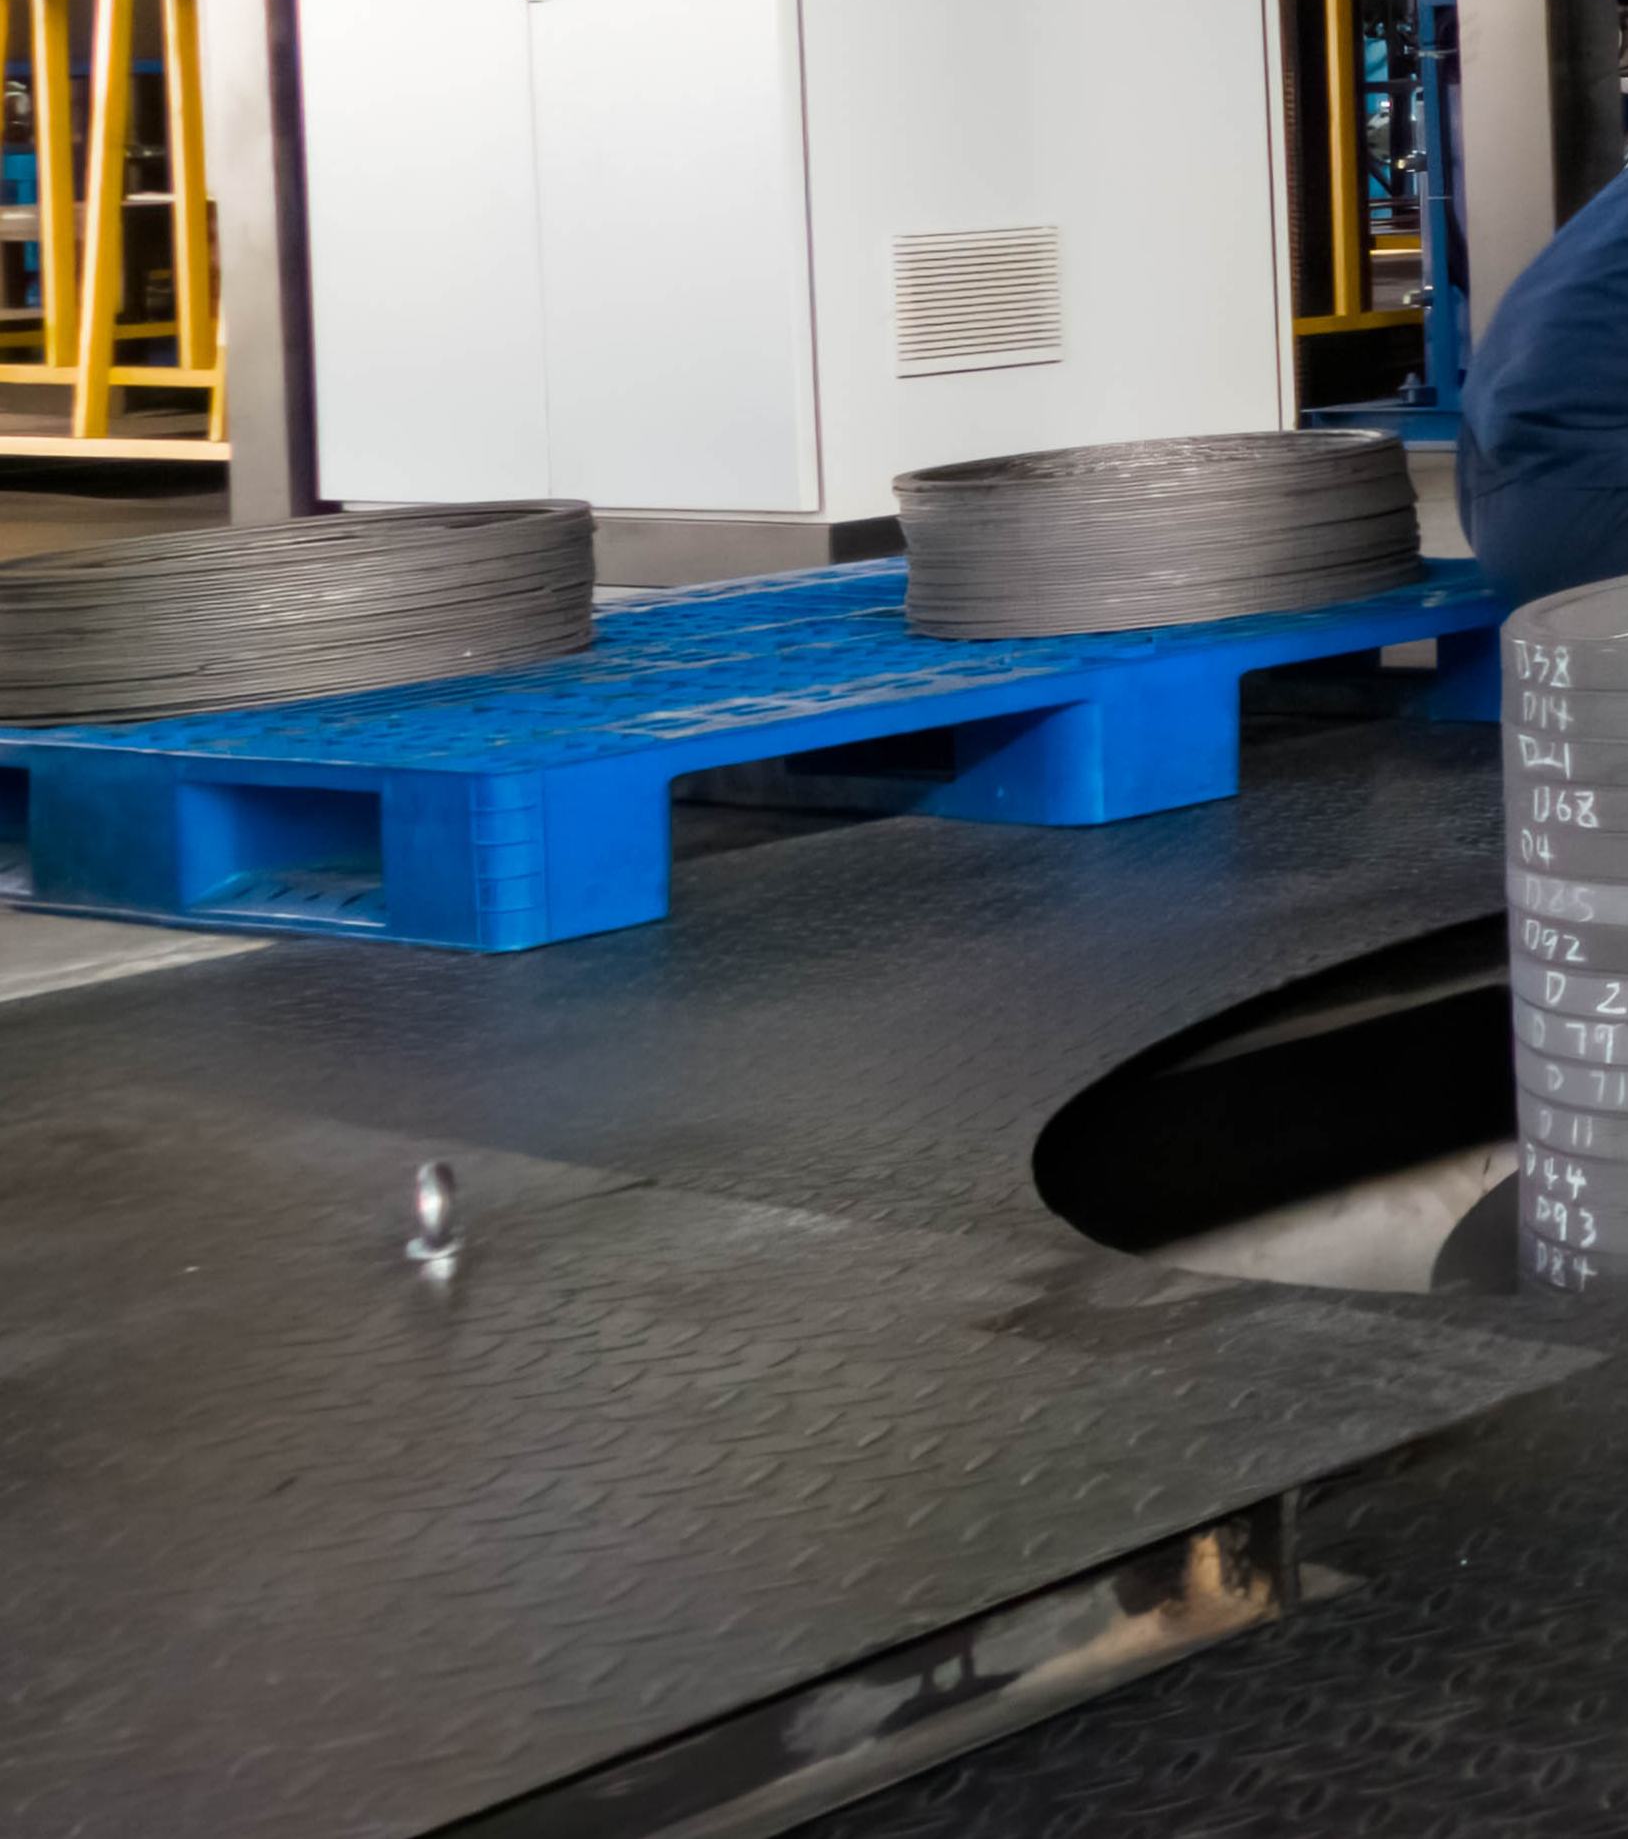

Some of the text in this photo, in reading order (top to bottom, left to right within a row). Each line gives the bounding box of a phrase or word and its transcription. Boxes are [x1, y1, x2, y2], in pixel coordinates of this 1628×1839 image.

[1523, 690, 1575, 732] D14
[1533, 785, 1600, 829] D68
[1521, 827, 1555, 865] D4
[1523, 918, 1588, 962] D92
[1535, 1194, 1598, 1249] D93
